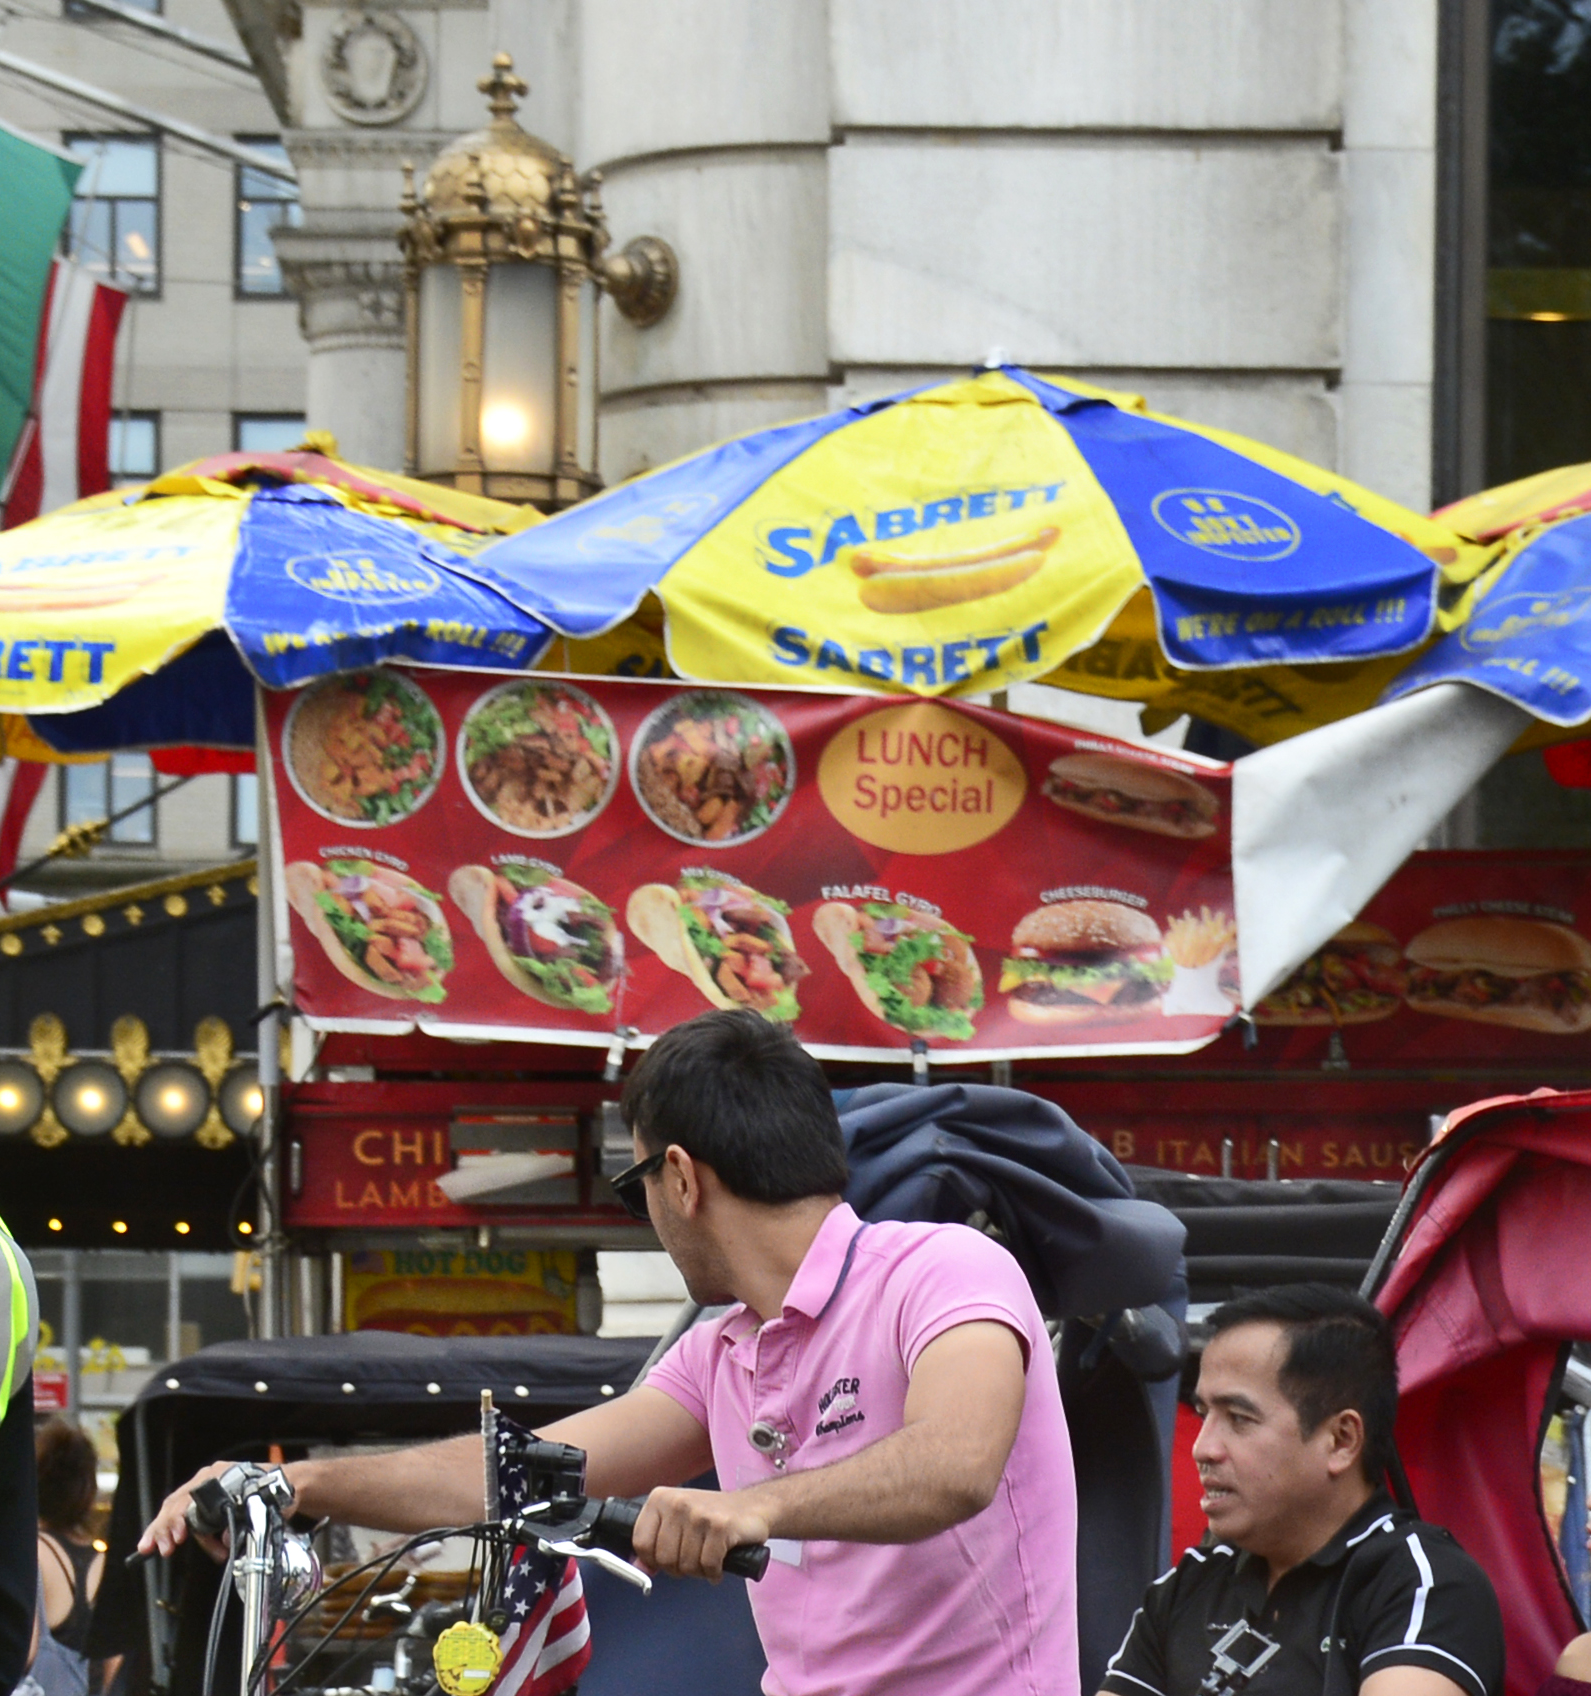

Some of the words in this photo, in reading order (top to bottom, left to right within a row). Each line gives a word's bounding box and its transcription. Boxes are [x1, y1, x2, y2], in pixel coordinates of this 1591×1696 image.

[763, 481, 1066, 578] SABRETT
[769, 620, 1050, 687] SABRETT
[857, 729, 988, 769] LUNCH
[853, 774, 993, 818] Special
[318, 844, 373, 859] CHICKEN
[375, 850, 410, 872] GYRO
[490, 853, 527, 866] LAMB
[528, 857, 564, 878] GYRO
[820, 884, 892, 903] FALAFEL
[895, 890, 943, 918] GYRO
[1039, 885, 1149, 910] CHEESEBURGER
[353, 1130, 444, 1165] CHI
[1158, 1140, 1305, 1168] ITAIN
[335, 1180, 450, 1210] LAMB
[394, 1249, 461, 1275] HOT
[463, 1249, 527, 1275] DOG
